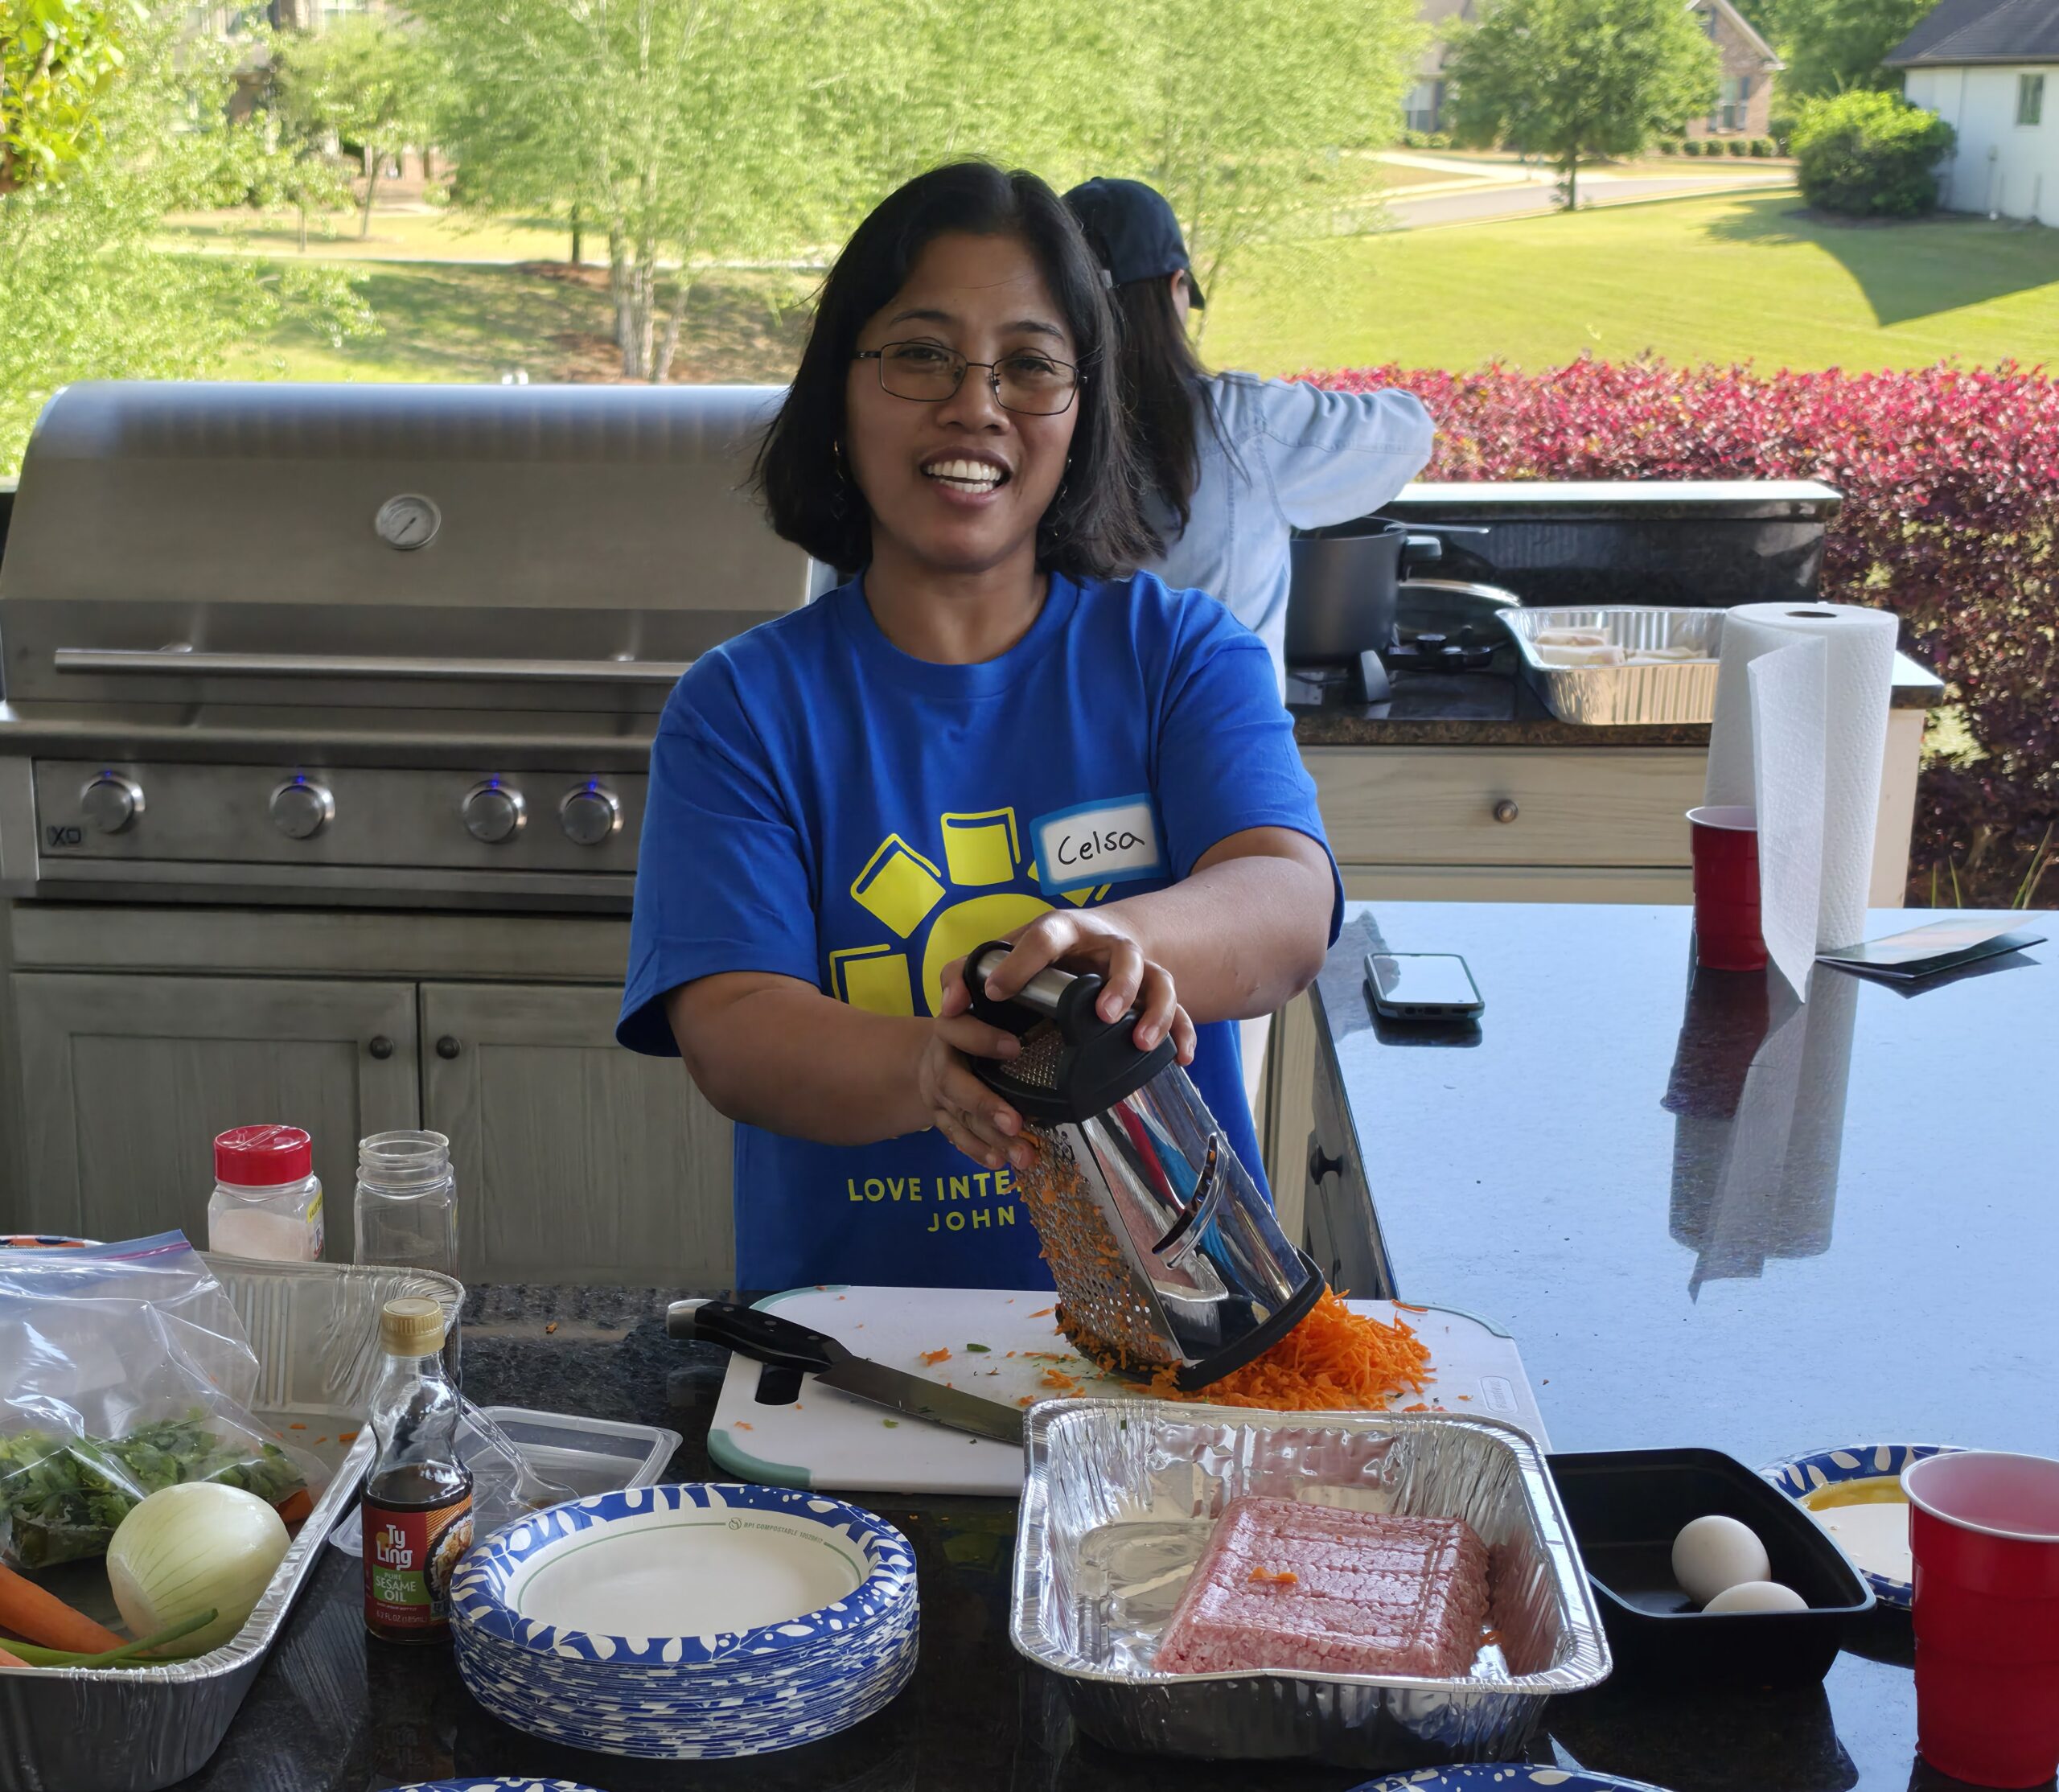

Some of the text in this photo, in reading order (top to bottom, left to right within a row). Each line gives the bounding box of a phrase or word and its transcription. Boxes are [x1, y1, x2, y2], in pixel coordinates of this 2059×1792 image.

[48, 826, 81, 847] XO
[1058, 831, 1145, 865] Celsa
[848, 1170, 1022, 1202] LOVE INTE
[927, 1206, 1015, 1232] JOHN
[386, 1523, 405, 1549] Ty
[756, 1523, 799, 1536] COMPOSTABLE
[376, 1540, 413, 1571] Ling
[376, 1576, 417, 1592] SESAME
[384, 1589, 407, 1602] OIL
